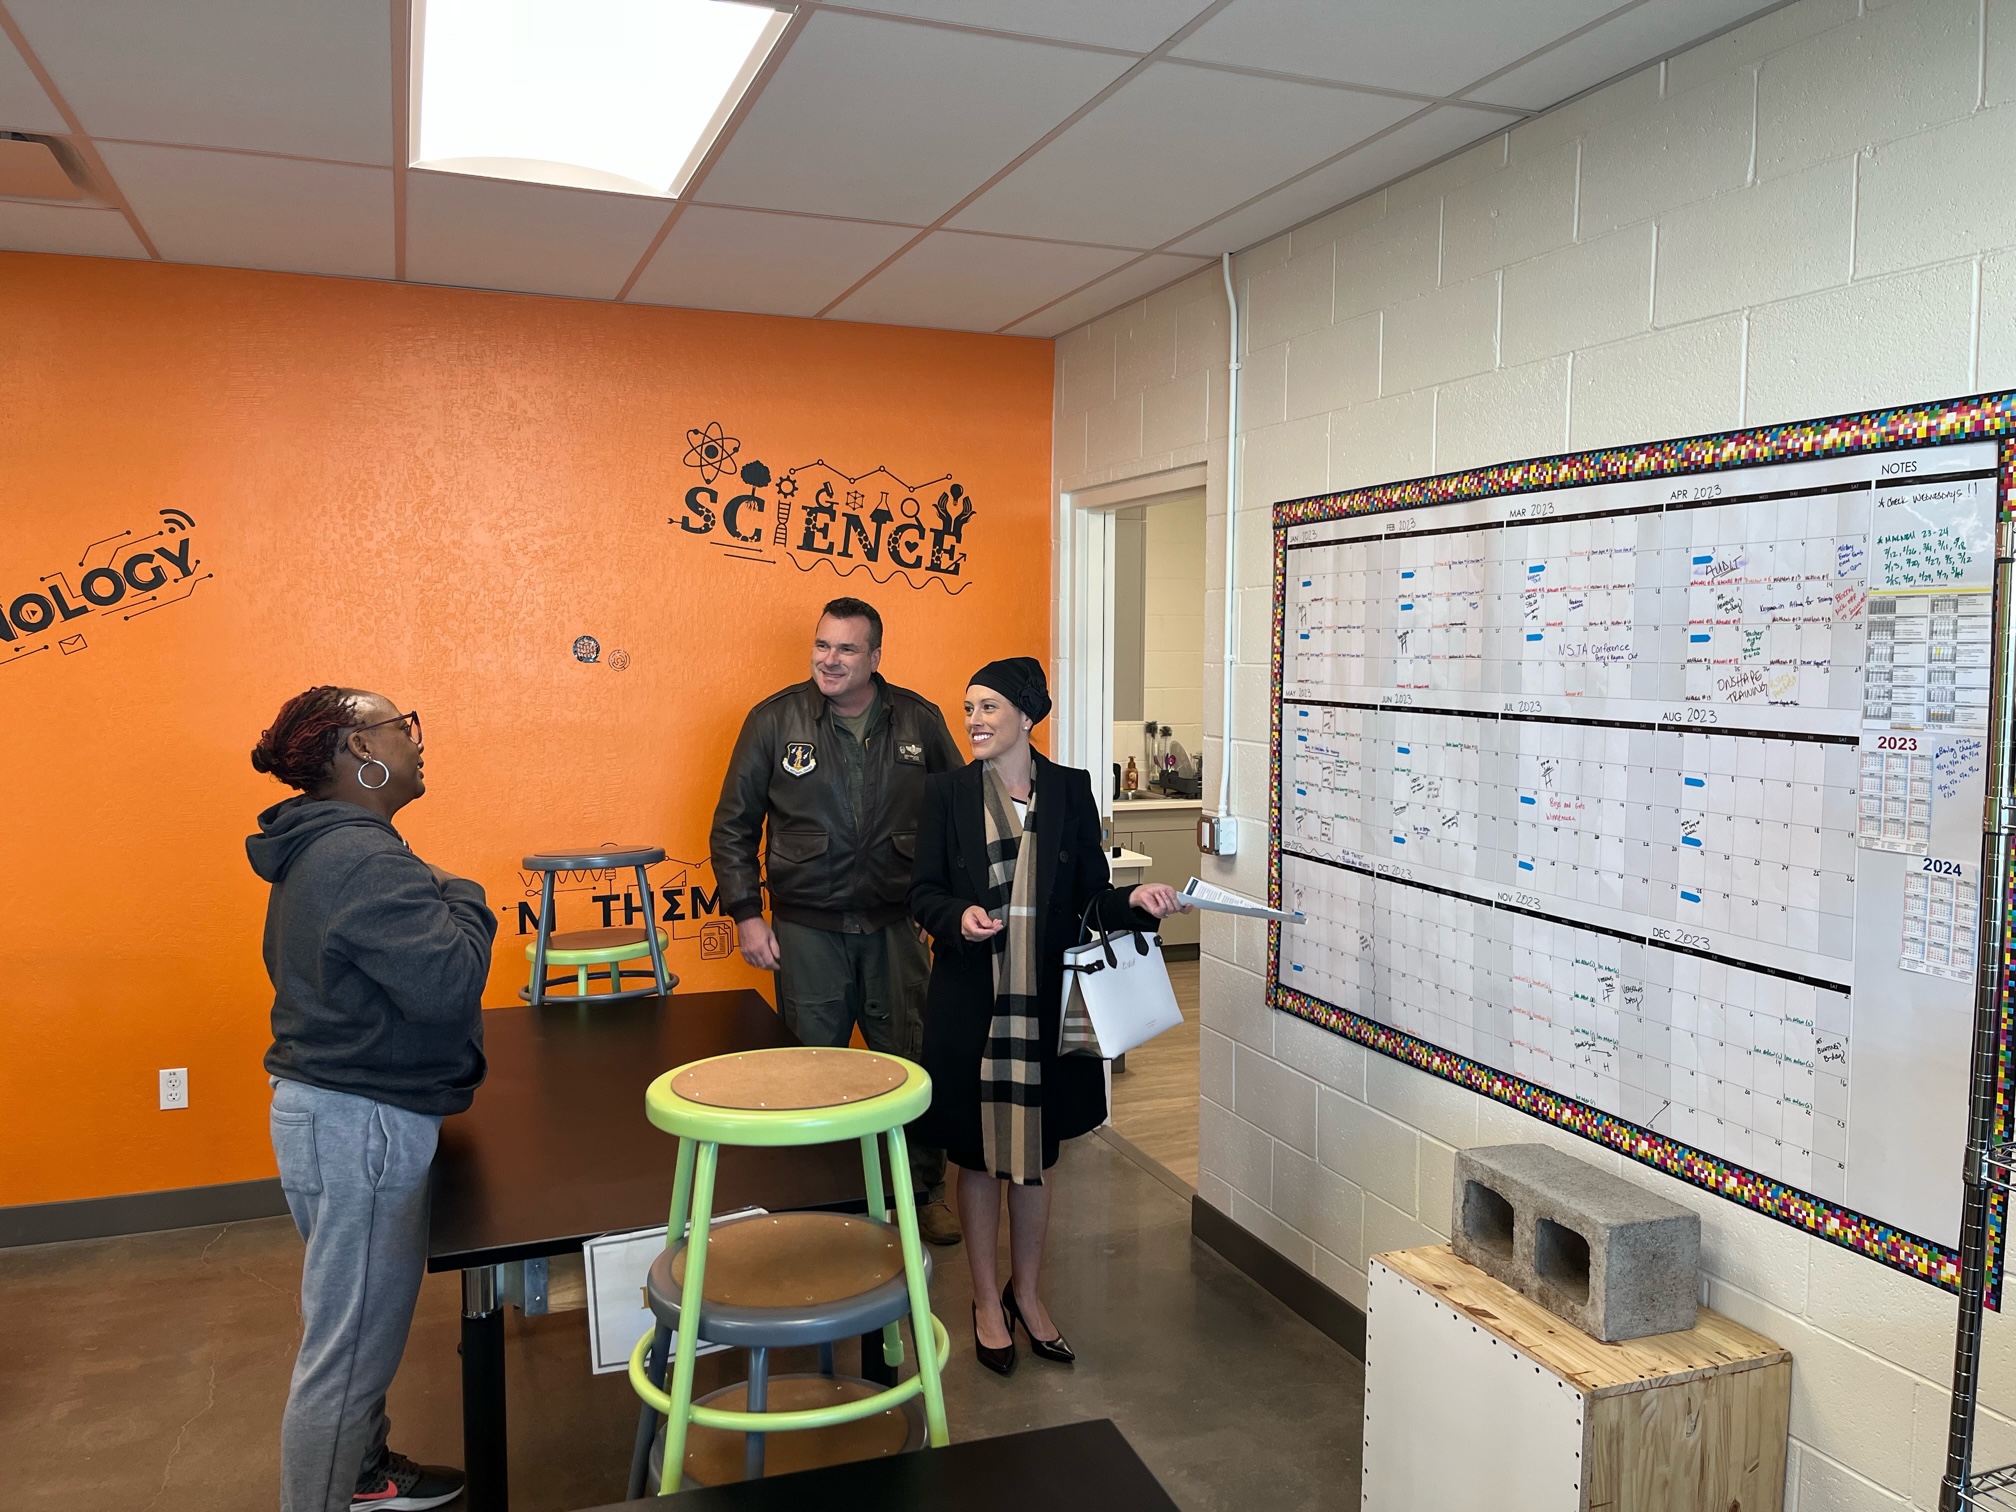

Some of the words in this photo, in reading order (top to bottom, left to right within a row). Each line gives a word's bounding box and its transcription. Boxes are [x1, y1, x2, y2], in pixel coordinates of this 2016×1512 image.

[1881, 461, 1917, 474] NOTES
[1670, 490, 1688, 500] APR
[1694, 484, 1722, 500] 2023
[1510, 509, 1526, 517] MAR
[1531, 502, 1554, 516] 2023
[680, 487, 963, 576] SCIENCE
[1717, 670, 1762, 691] ONSHAPE
[1395, 694, 1412, 705] 2023
[1726, 682, 1768, 703] TRAINING
[1504, 703, 1513, 711] JUL
[1518, 701, 1542, 712] 2023
[1662, 713, 1682, 722] AUG
[1687, 708, 1717, 723] 2023
[1878, 736, 1918, 750] 2023
[1923, 858, 1962, 876] 2024
[1498, 892, 1513, 902] NOV
[1516, 892, 1541, 910] 2023
[1653, 928, 1670, 940] DEC
[1675, 929, 1710, 950] 2023
